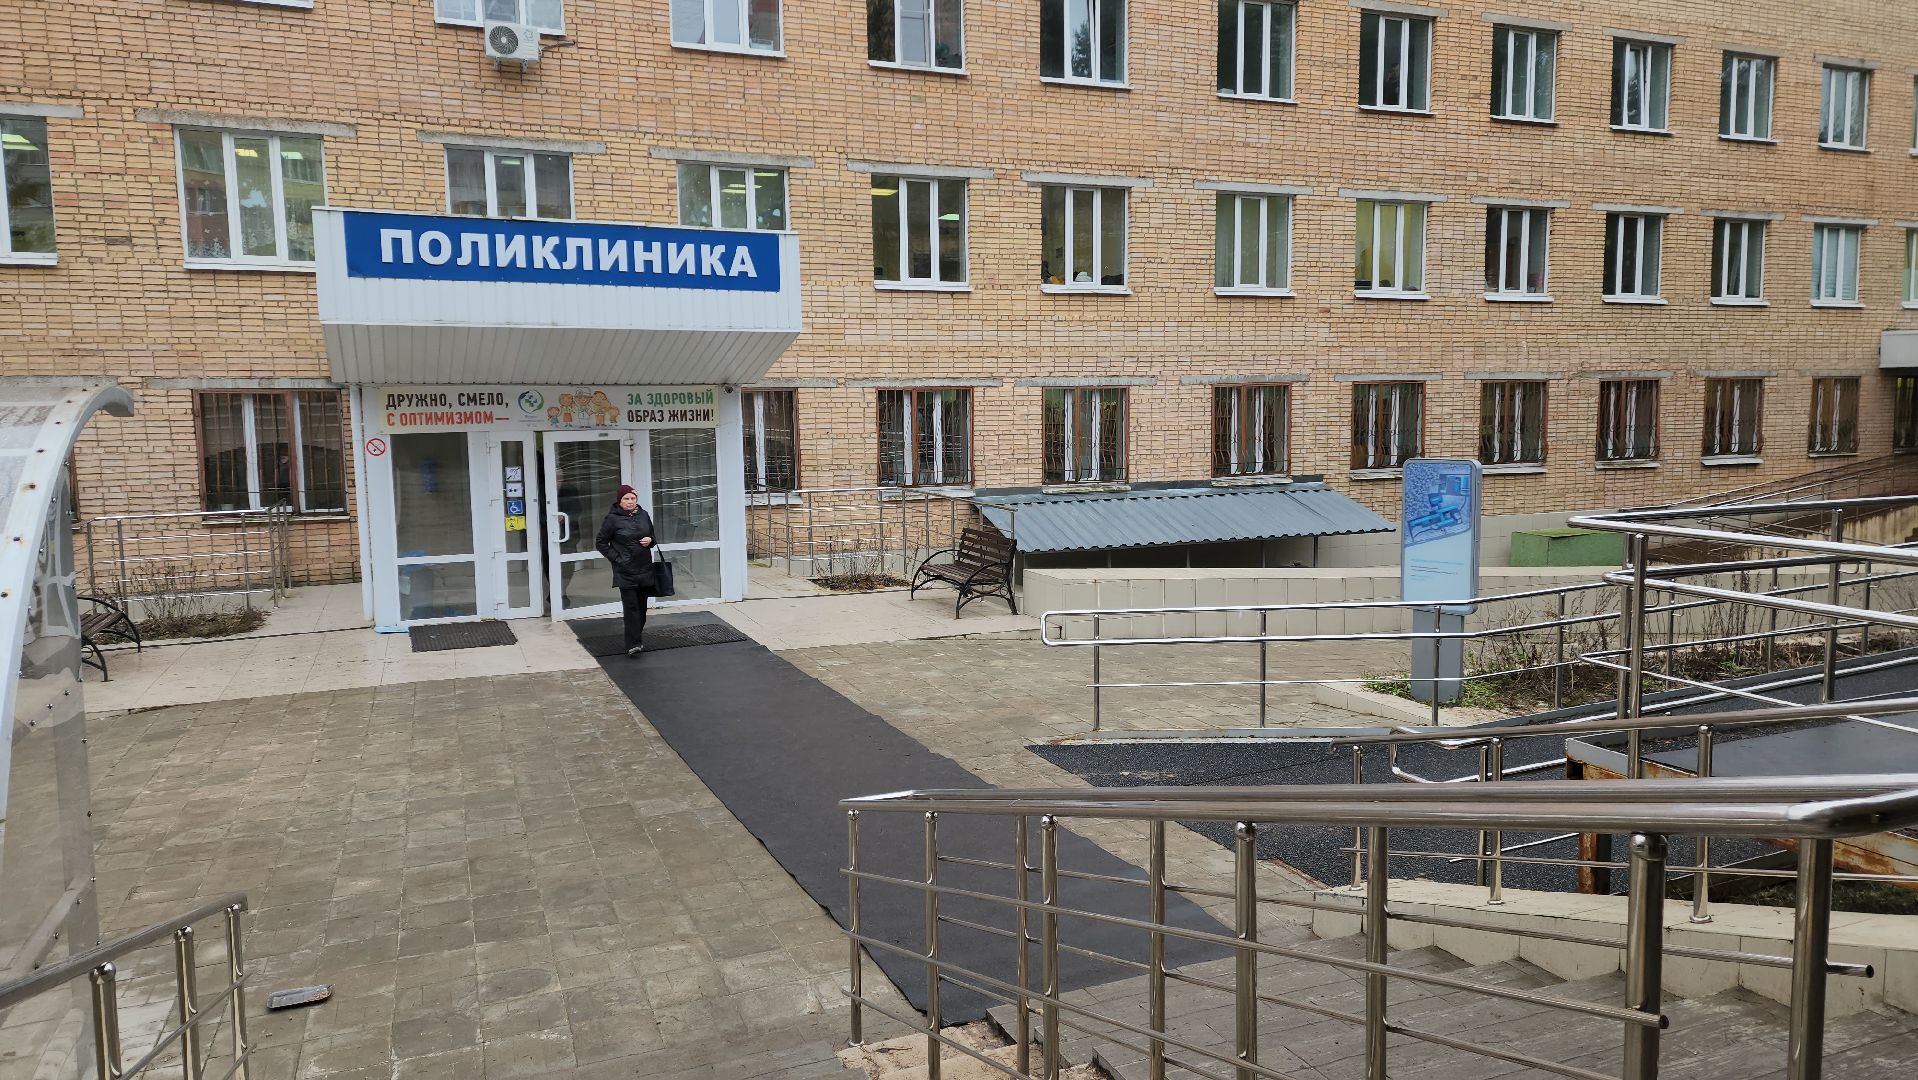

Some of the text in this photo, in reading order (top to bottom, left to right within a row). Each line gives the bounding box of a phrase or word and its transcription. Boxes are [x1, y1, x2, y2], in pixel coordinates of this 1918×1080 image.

[380, 228, 758, 278] ПОЛИКЛИНИКА
[386, 392, 510, 410] ДРУЖНО, СМЕЛО,
[627, 388, 714, 407] ЗА ЗДОРОВЫЙ
[387, 412, 396, 427] С
[627, 408, 714, 423] ОБРАЗ ЖИЗНИ!
